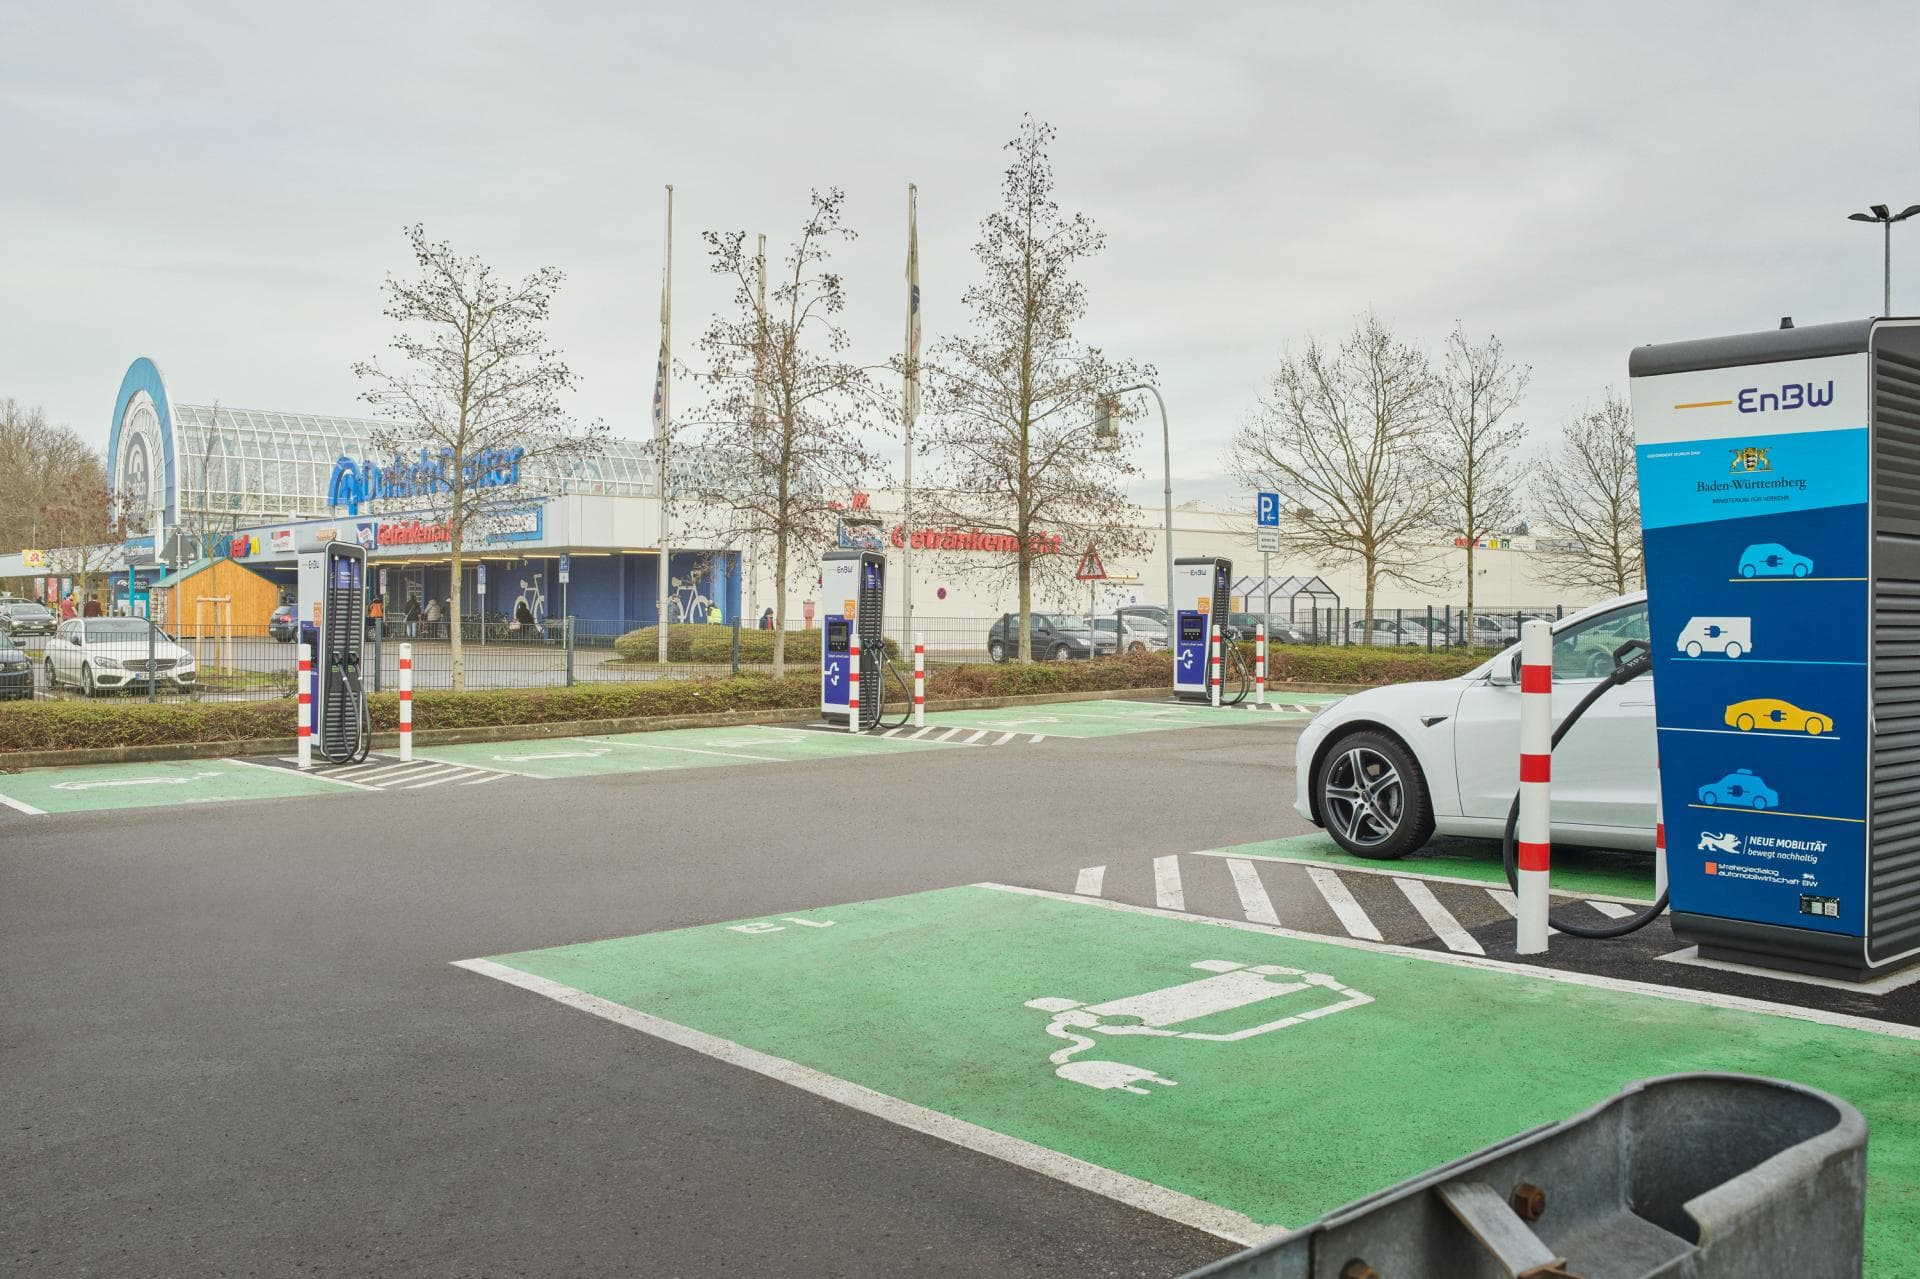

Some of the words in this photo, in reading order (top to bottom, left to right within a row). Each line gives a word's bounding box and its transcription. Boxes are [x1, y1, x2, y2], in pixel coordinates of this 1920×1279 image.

[1738, 380, 1834, 413] EnBW
[1697, 477, 1807, 492] Baden-Württemberg
[1261, 497, 1273, 521] P
[377, 517, 463, 545] Getränkemark
[891, 524, 1062, 555] Getränkemrkt
[1749, 835, 1776, 847] NEUE
[1775, 839, 1828, 853] MOBILITÄT
[1747, 848, 1776, 860] bewegt
[1776, 852, 1818, 865] nachhaltig
[1718, 863, 1780, 877] strategiedialog
[1718, 871, 1801, 886] automobilwirtschaft
